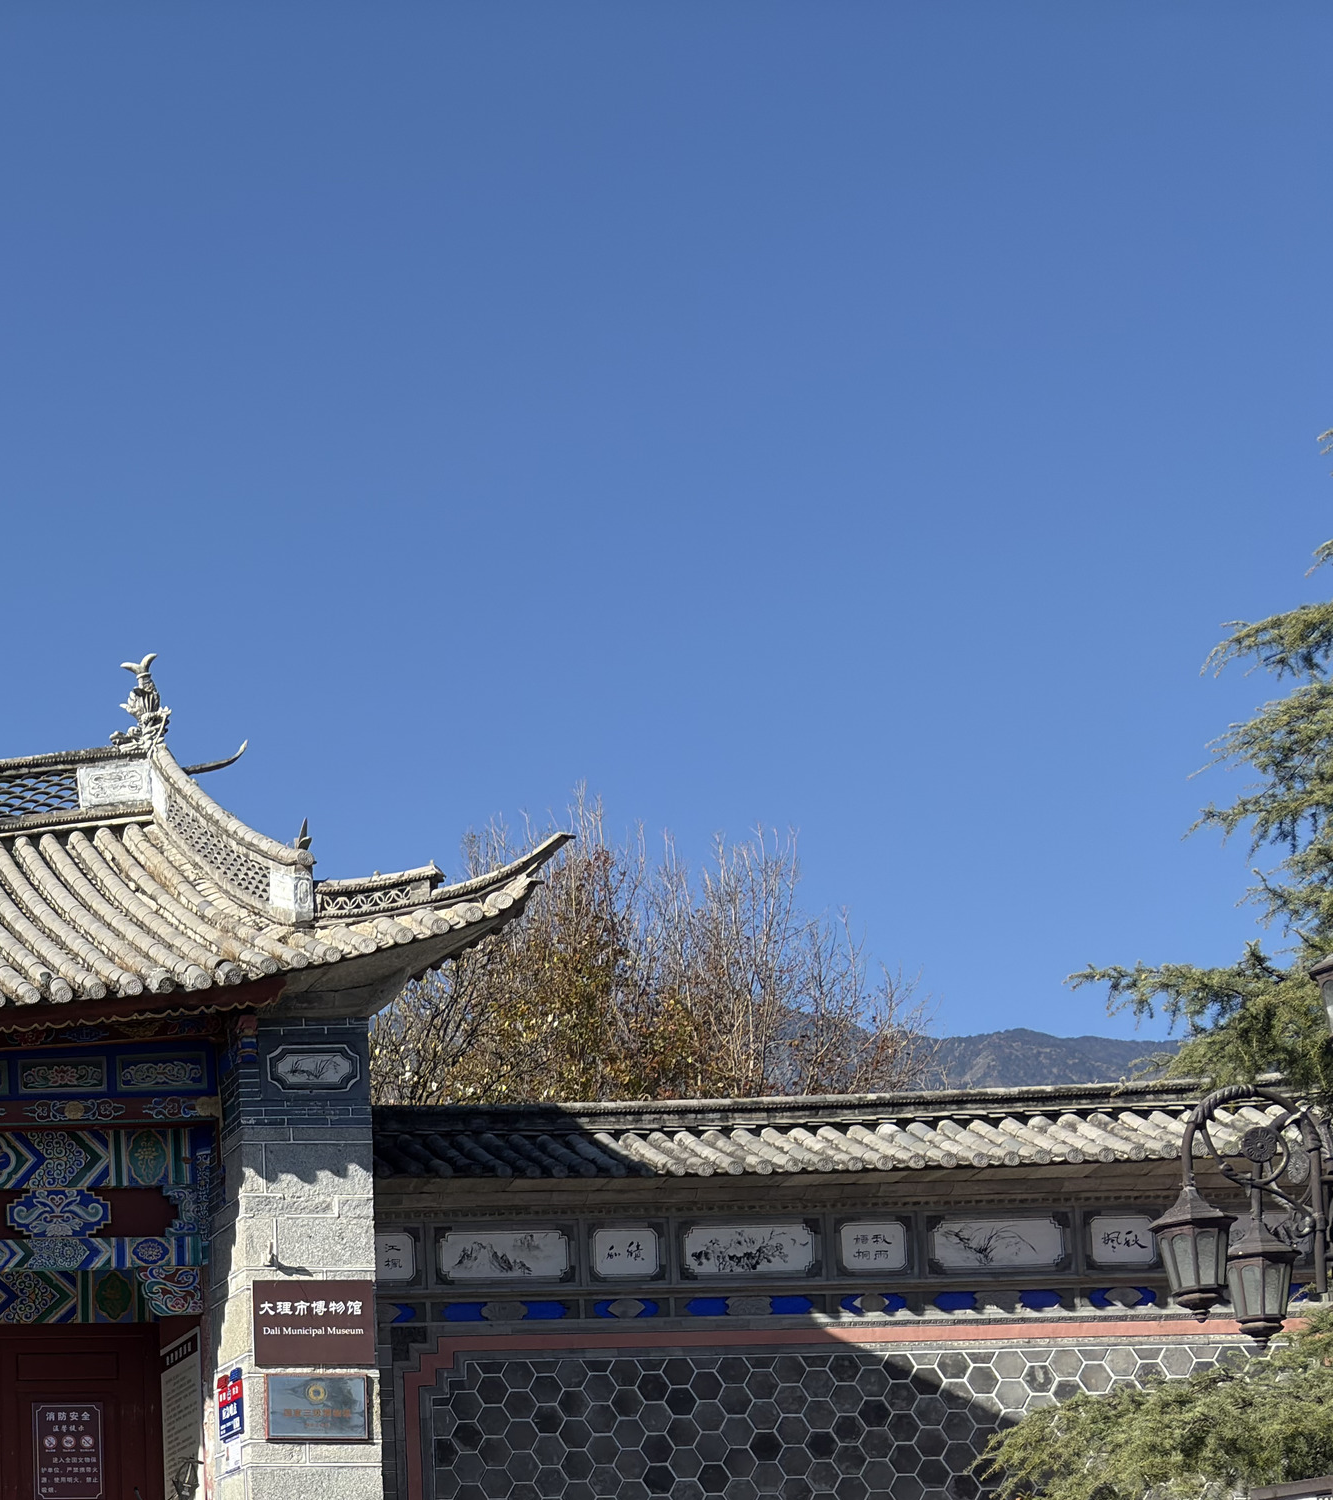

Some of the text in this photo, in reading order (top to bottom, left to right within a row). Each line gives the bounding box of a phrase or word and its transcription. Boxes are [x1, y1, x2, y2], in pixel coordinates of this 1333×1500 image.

[258, 1300, 363, 1316] 大理市博物馆
[263, 1326, 364, 1337] Dali Municipal Museum
[45, 1411, 91, 1421] 消防安全
